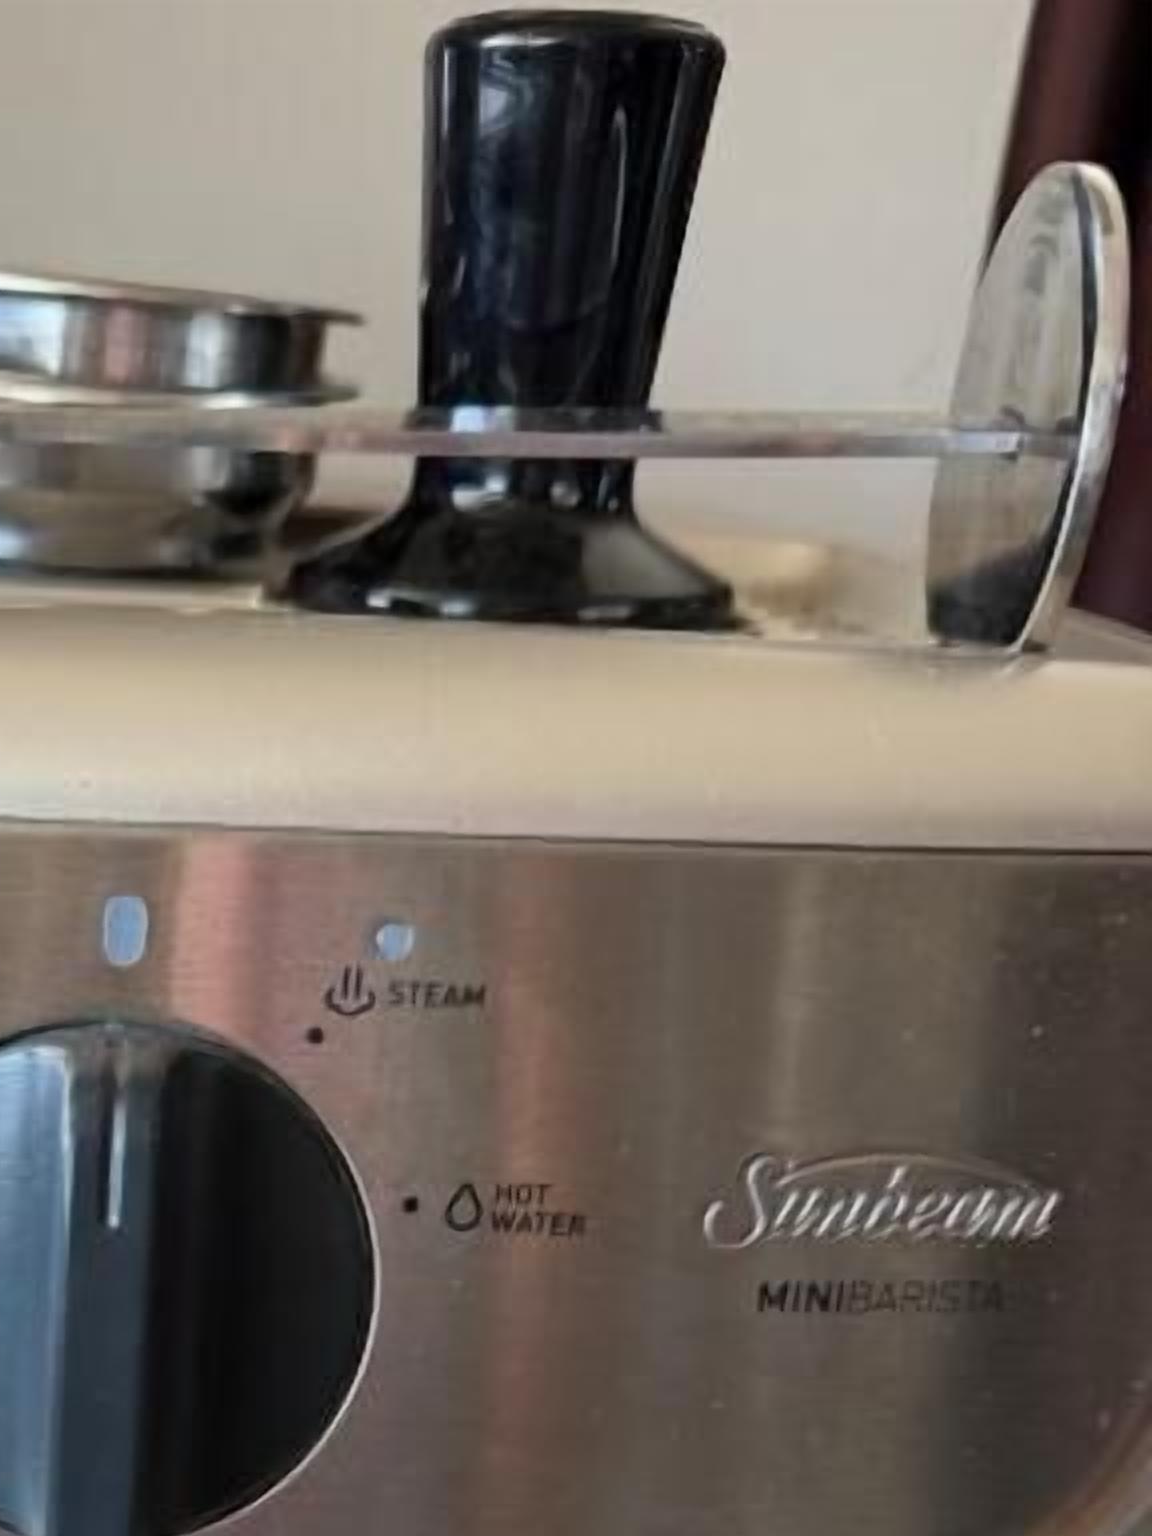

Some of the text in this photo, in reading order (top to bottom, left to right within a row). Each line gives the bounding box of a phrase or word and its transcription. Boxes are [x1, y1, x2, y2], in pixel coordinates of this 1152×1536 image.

[388, 980, 486, 1009] STEAM
[494, 1183, 553, 1206] HOT
[703, 1152, 1061, 1250] Sunbeam
[491, 1211, 586, 1238] WATER
